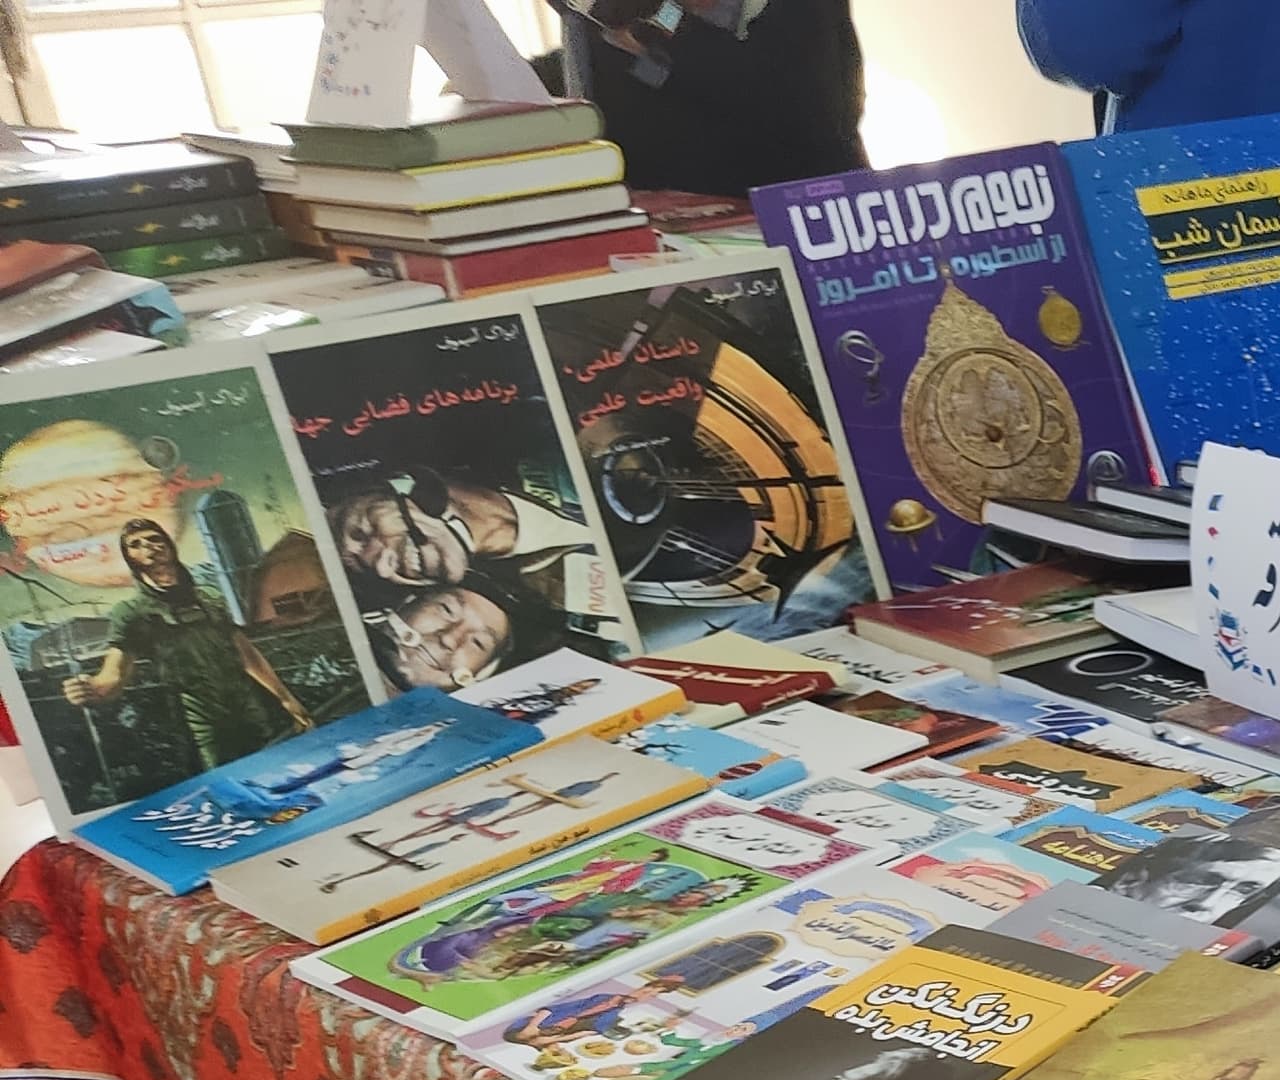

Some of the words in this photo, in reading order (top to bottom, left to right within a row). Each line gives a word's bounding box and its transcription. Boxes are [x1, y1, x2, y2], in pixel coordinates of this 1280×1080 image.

[903, 180, 952, 243] در
[950, 164, 1056, 236] نجوم
[787, 188, 911, 262] ایران
[1151, 216, 1211, 259] شب
[904, 256, 939, 284] تا
[951, 237, 1049, 281] اسطوره
[1051, 233, 1067, 264] از
[816, 263, 899, 307] امروز
[634, 337, 700, 363] داستان
[578, 392, 628, 428] علمی
[637, 376, 704, 406] واقعیت
[342, 392, 411, 436] فضایی
[863, 980, 962, 1016] نکن
[953, 990, 1033, 1035] درنگ
[833, 1004, 898, 1040] بده
[870, 1014, 1000, 1063] انجامش
